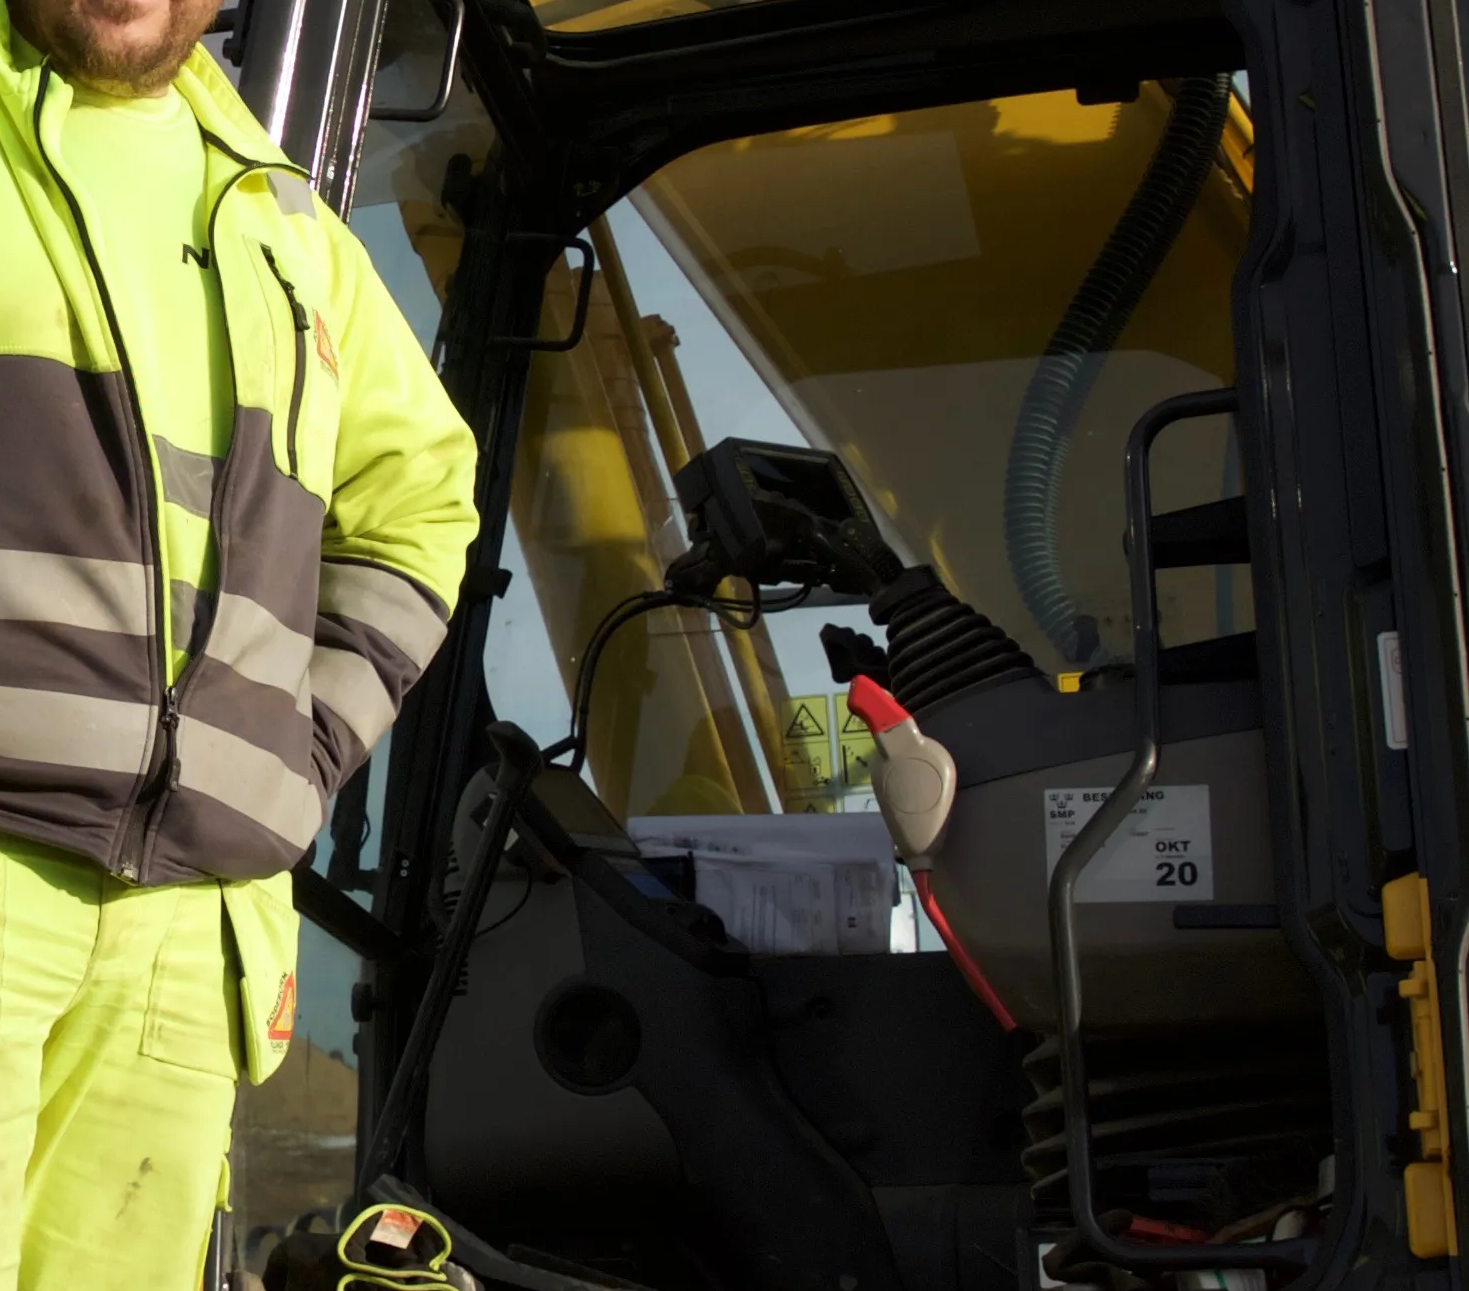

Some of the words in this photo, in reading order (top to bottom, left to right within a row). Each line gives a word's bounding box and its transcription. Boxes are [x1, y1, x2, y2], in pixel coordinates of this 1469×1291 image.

[1050, 810, 1075, 819] SMP
[1155, 840, 1191, 853] OKT
[1155, 861, 1198, 887] 20
